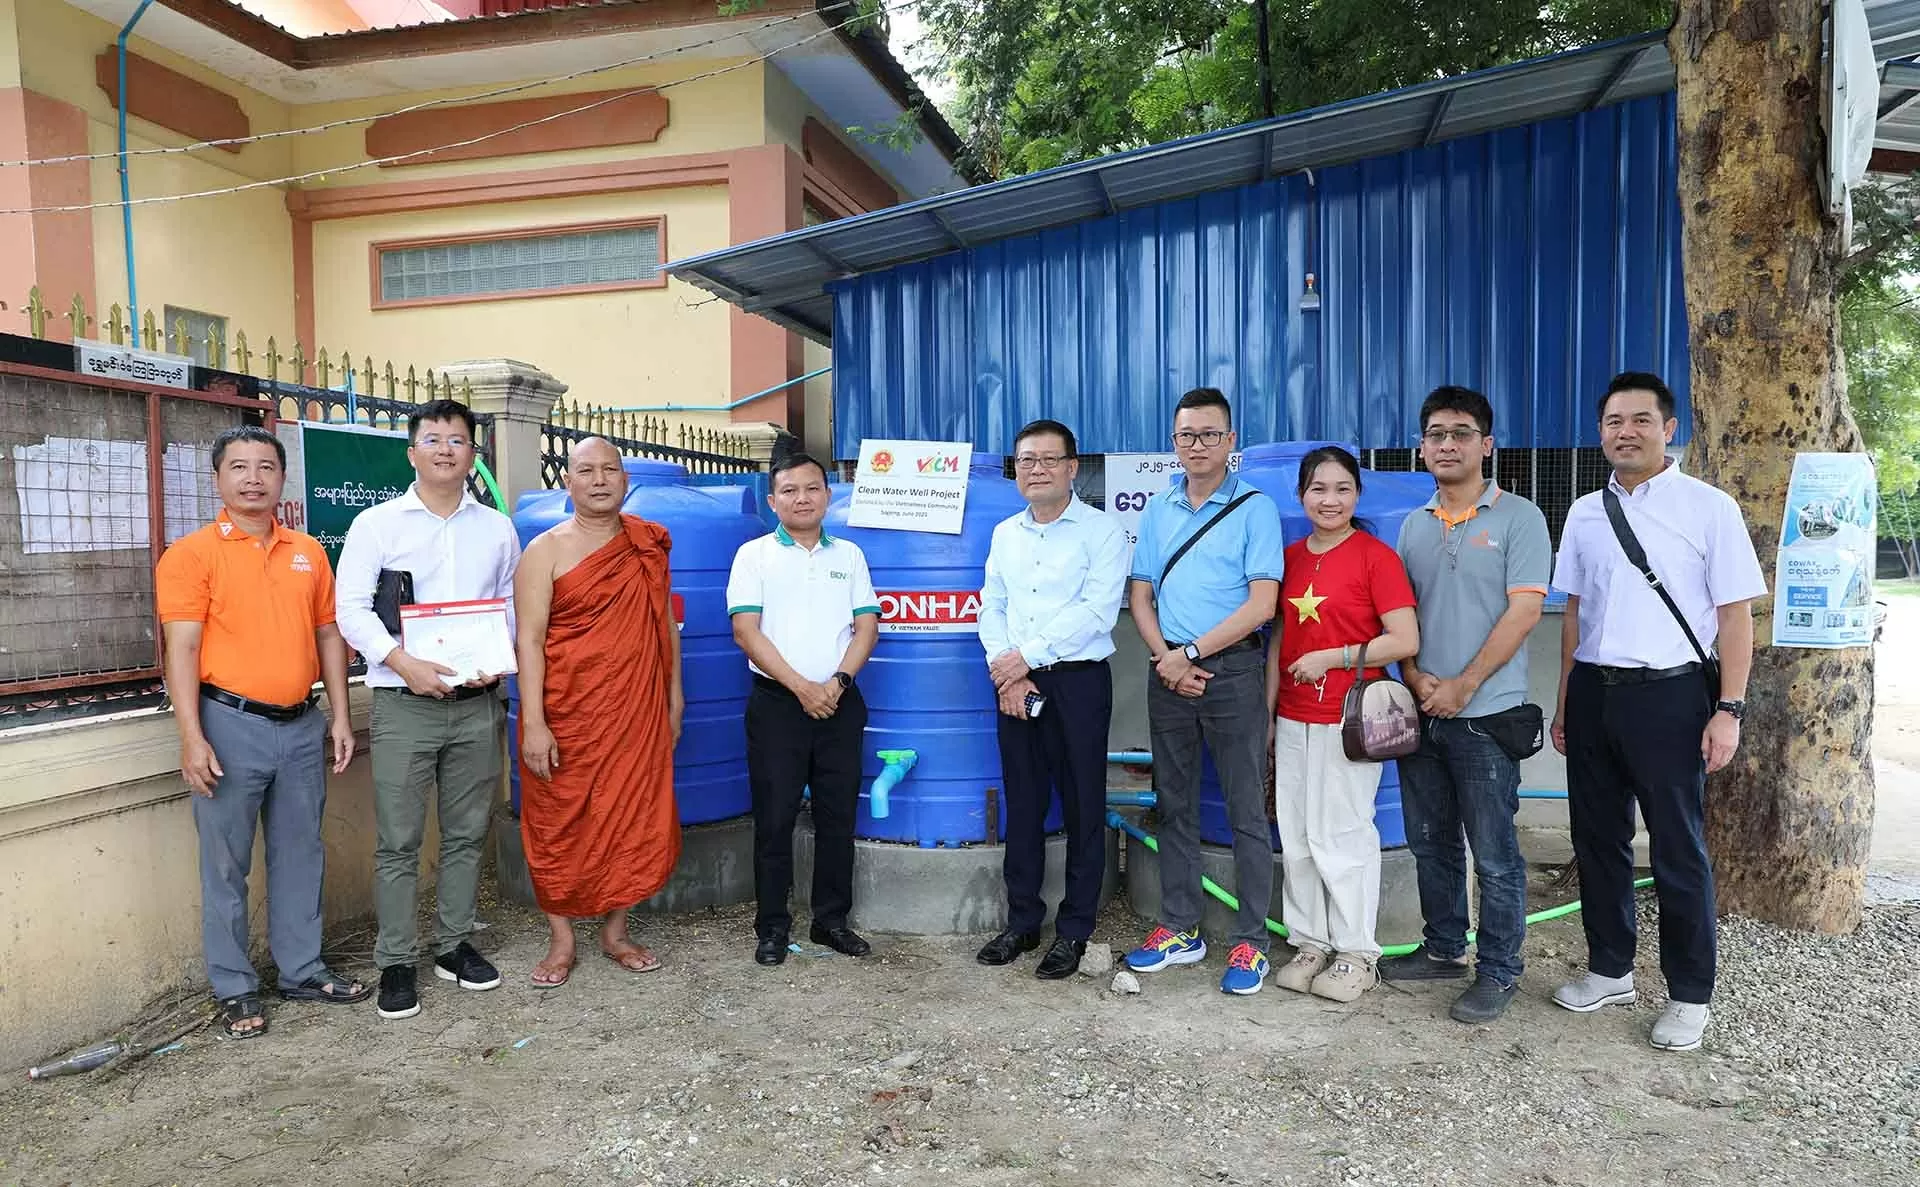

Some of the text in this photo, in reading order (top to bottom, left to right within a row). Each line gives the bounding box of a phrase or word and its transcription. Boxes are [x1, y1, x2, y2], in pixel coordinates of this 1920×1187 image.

[858, 486, 961, 500] Clean Water Well Project
[928, 502, 959, 511] Community
[877, 595, 983, 619] ONHA
